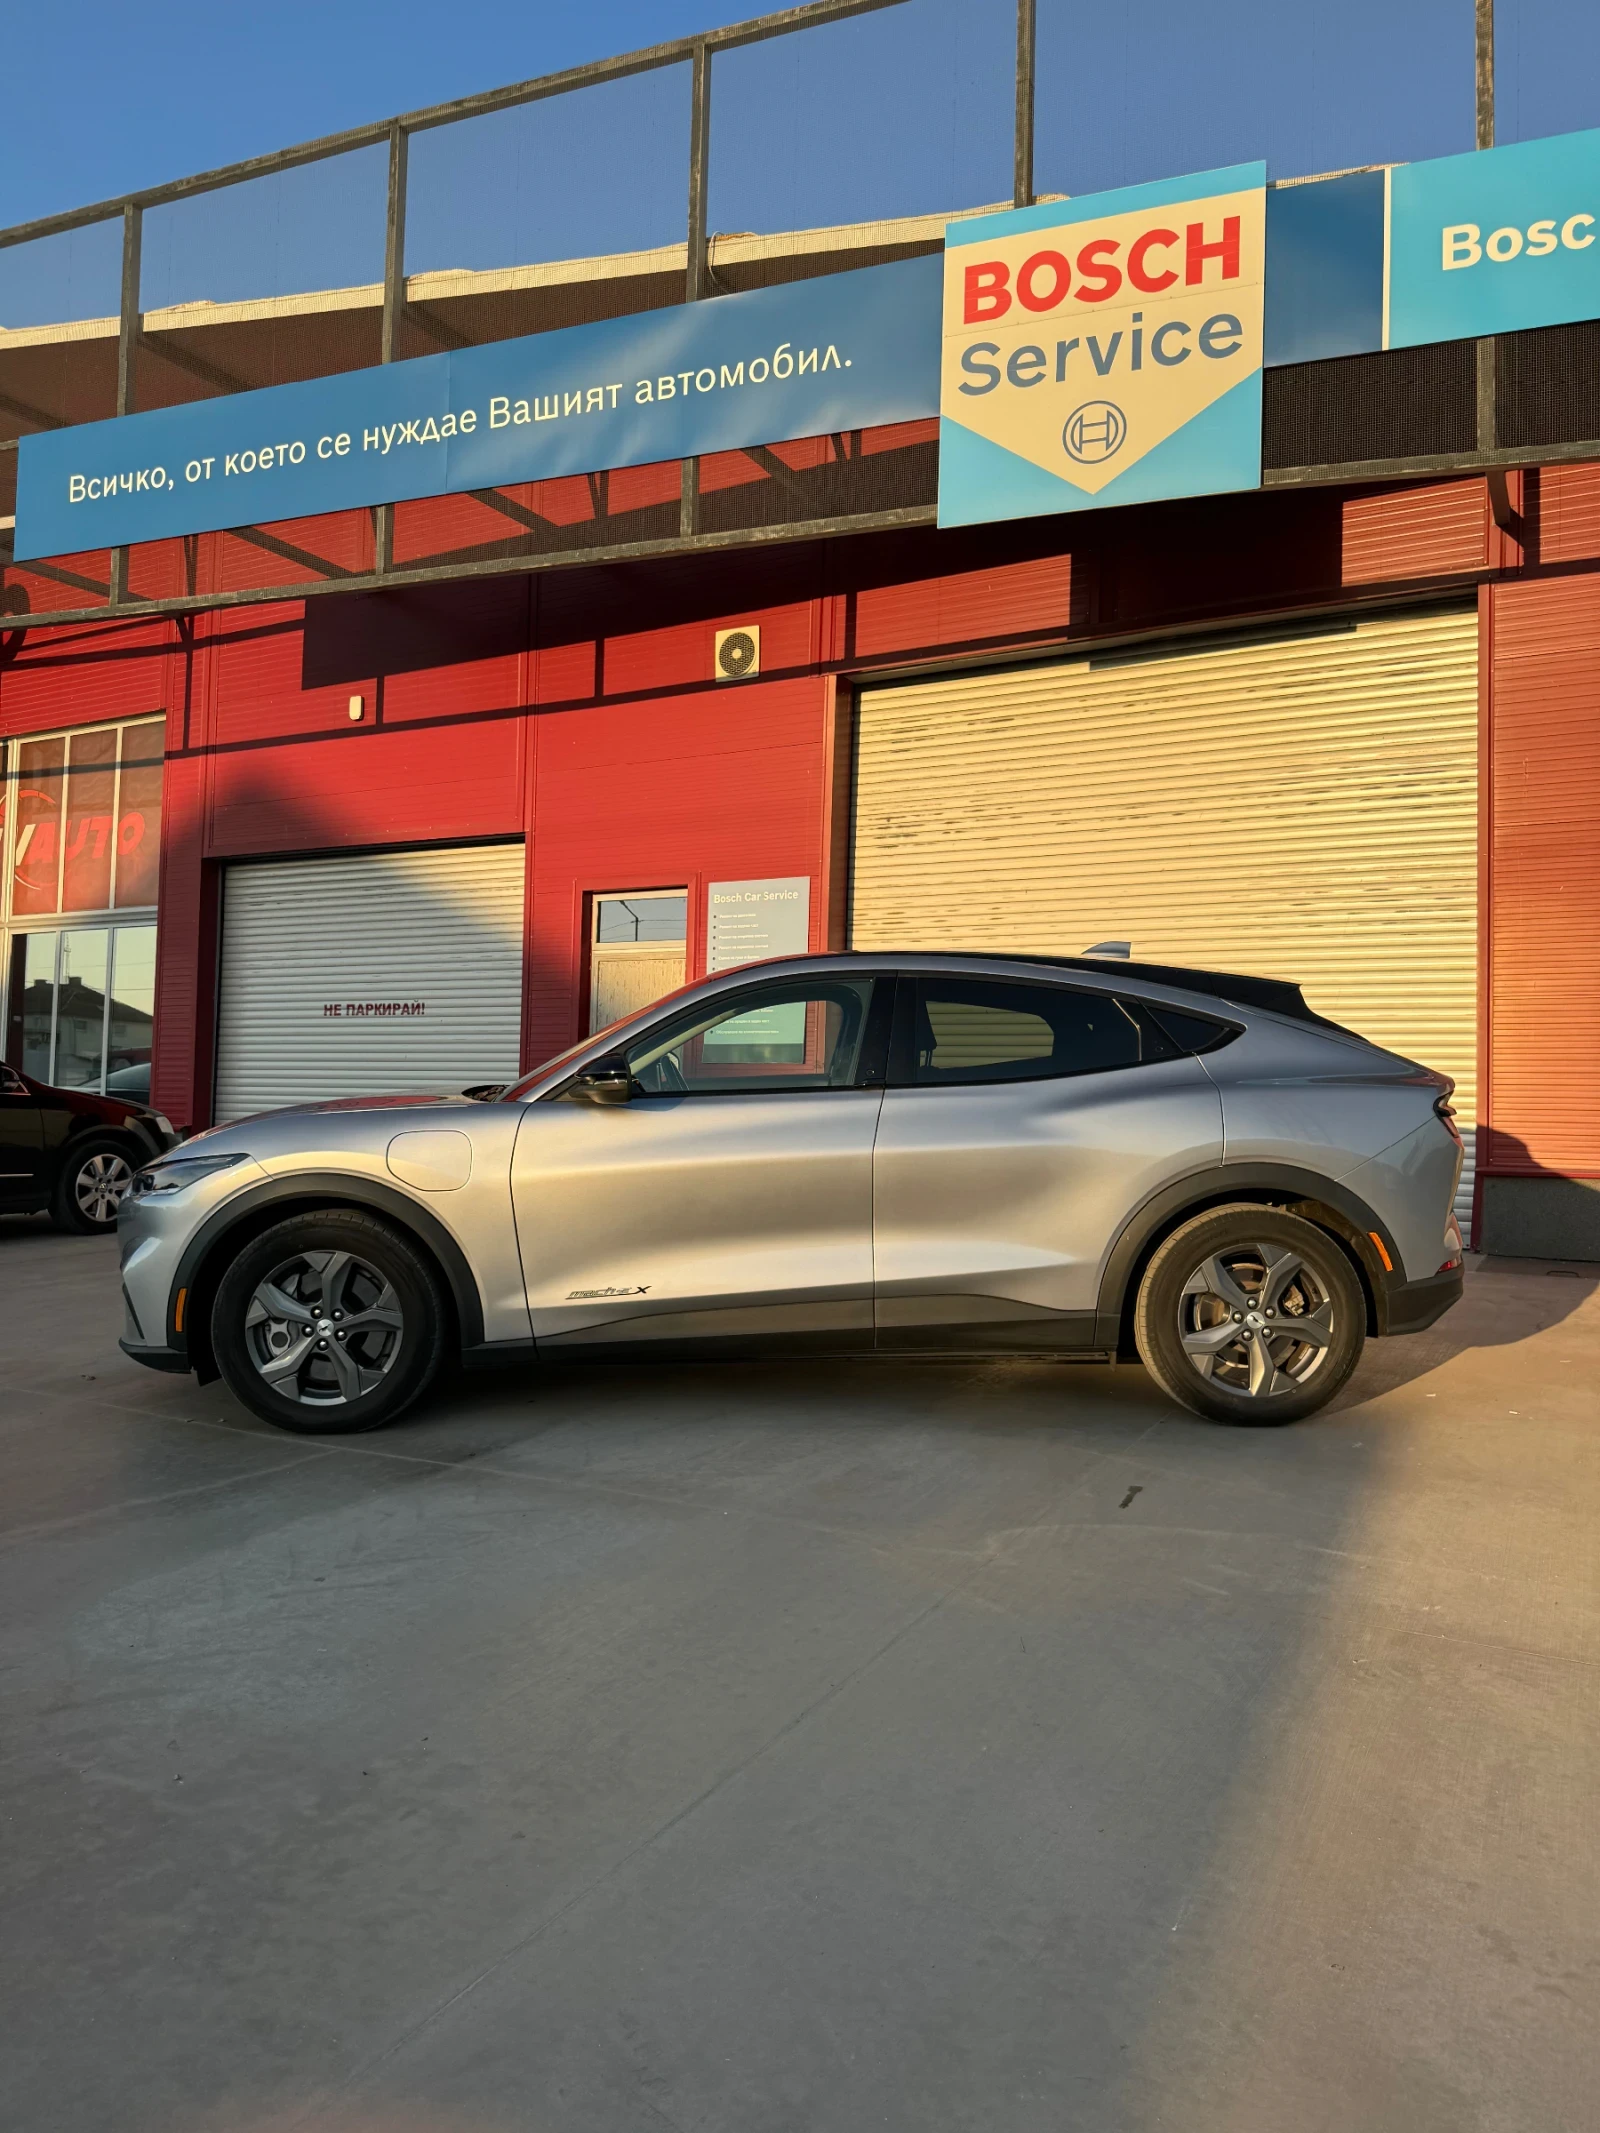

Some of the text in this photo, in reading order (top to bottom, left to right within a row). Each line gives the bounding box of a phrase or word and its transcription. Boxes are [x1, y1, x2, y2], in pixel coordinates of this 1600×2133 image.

[963, 215, 1241, 325] BOSCH
[1442, 213, 1596, 271] Bosc
[958, 312, 1243, 396] Service
[68, 343, 853, 503] Всичко, от което се нуждае Вашият автомобил.
[713, 889, 799, 904] Bosch Car Service
[323, 999, 425, 1016] НЕ ПАРКИРАЙ!
